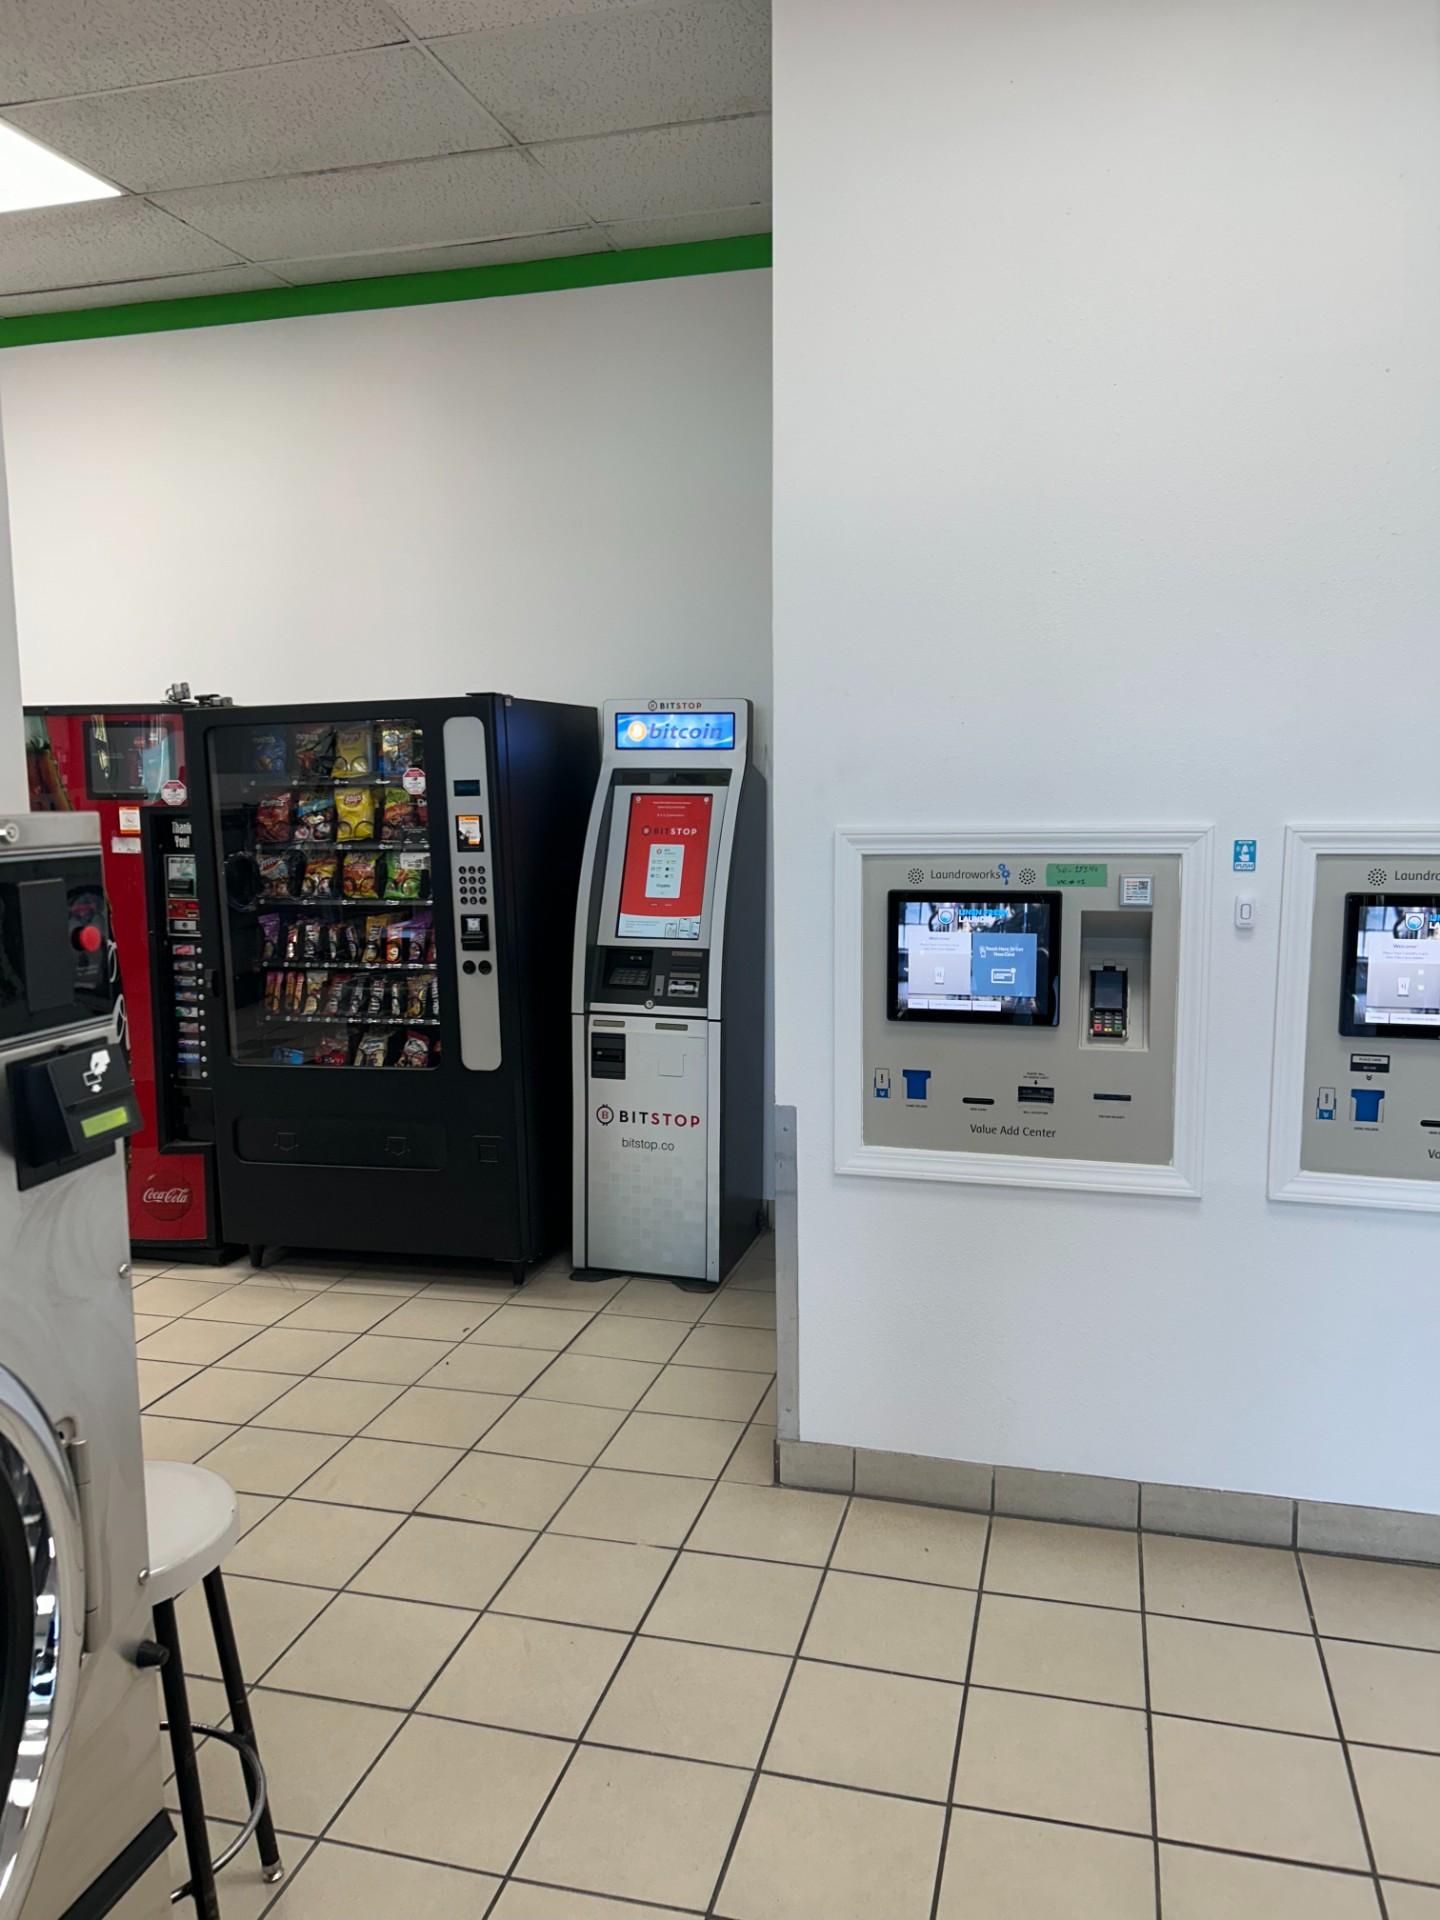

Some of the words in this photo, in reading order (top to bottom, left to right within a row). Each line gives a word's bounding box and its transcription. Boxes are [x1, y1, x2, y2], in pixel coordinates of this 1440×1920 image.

[660, 702, 702, 710] BITSTOP
[650, 723, 722, 739] bitcoin
[172, 822, 192, 834] Thank
[174, 836, 190, 848] You!
[930, 869, 1001, 880] Laundroworks
[619, 1110, 700, 1128] BITSTOP
[970, 1123, 997, 1135] Value
[1000, 1125, 1020, 1136] Add
[1022, 1127, 1056, 1138] Center
[622, 1137, 675, 1152] bitstop.co
